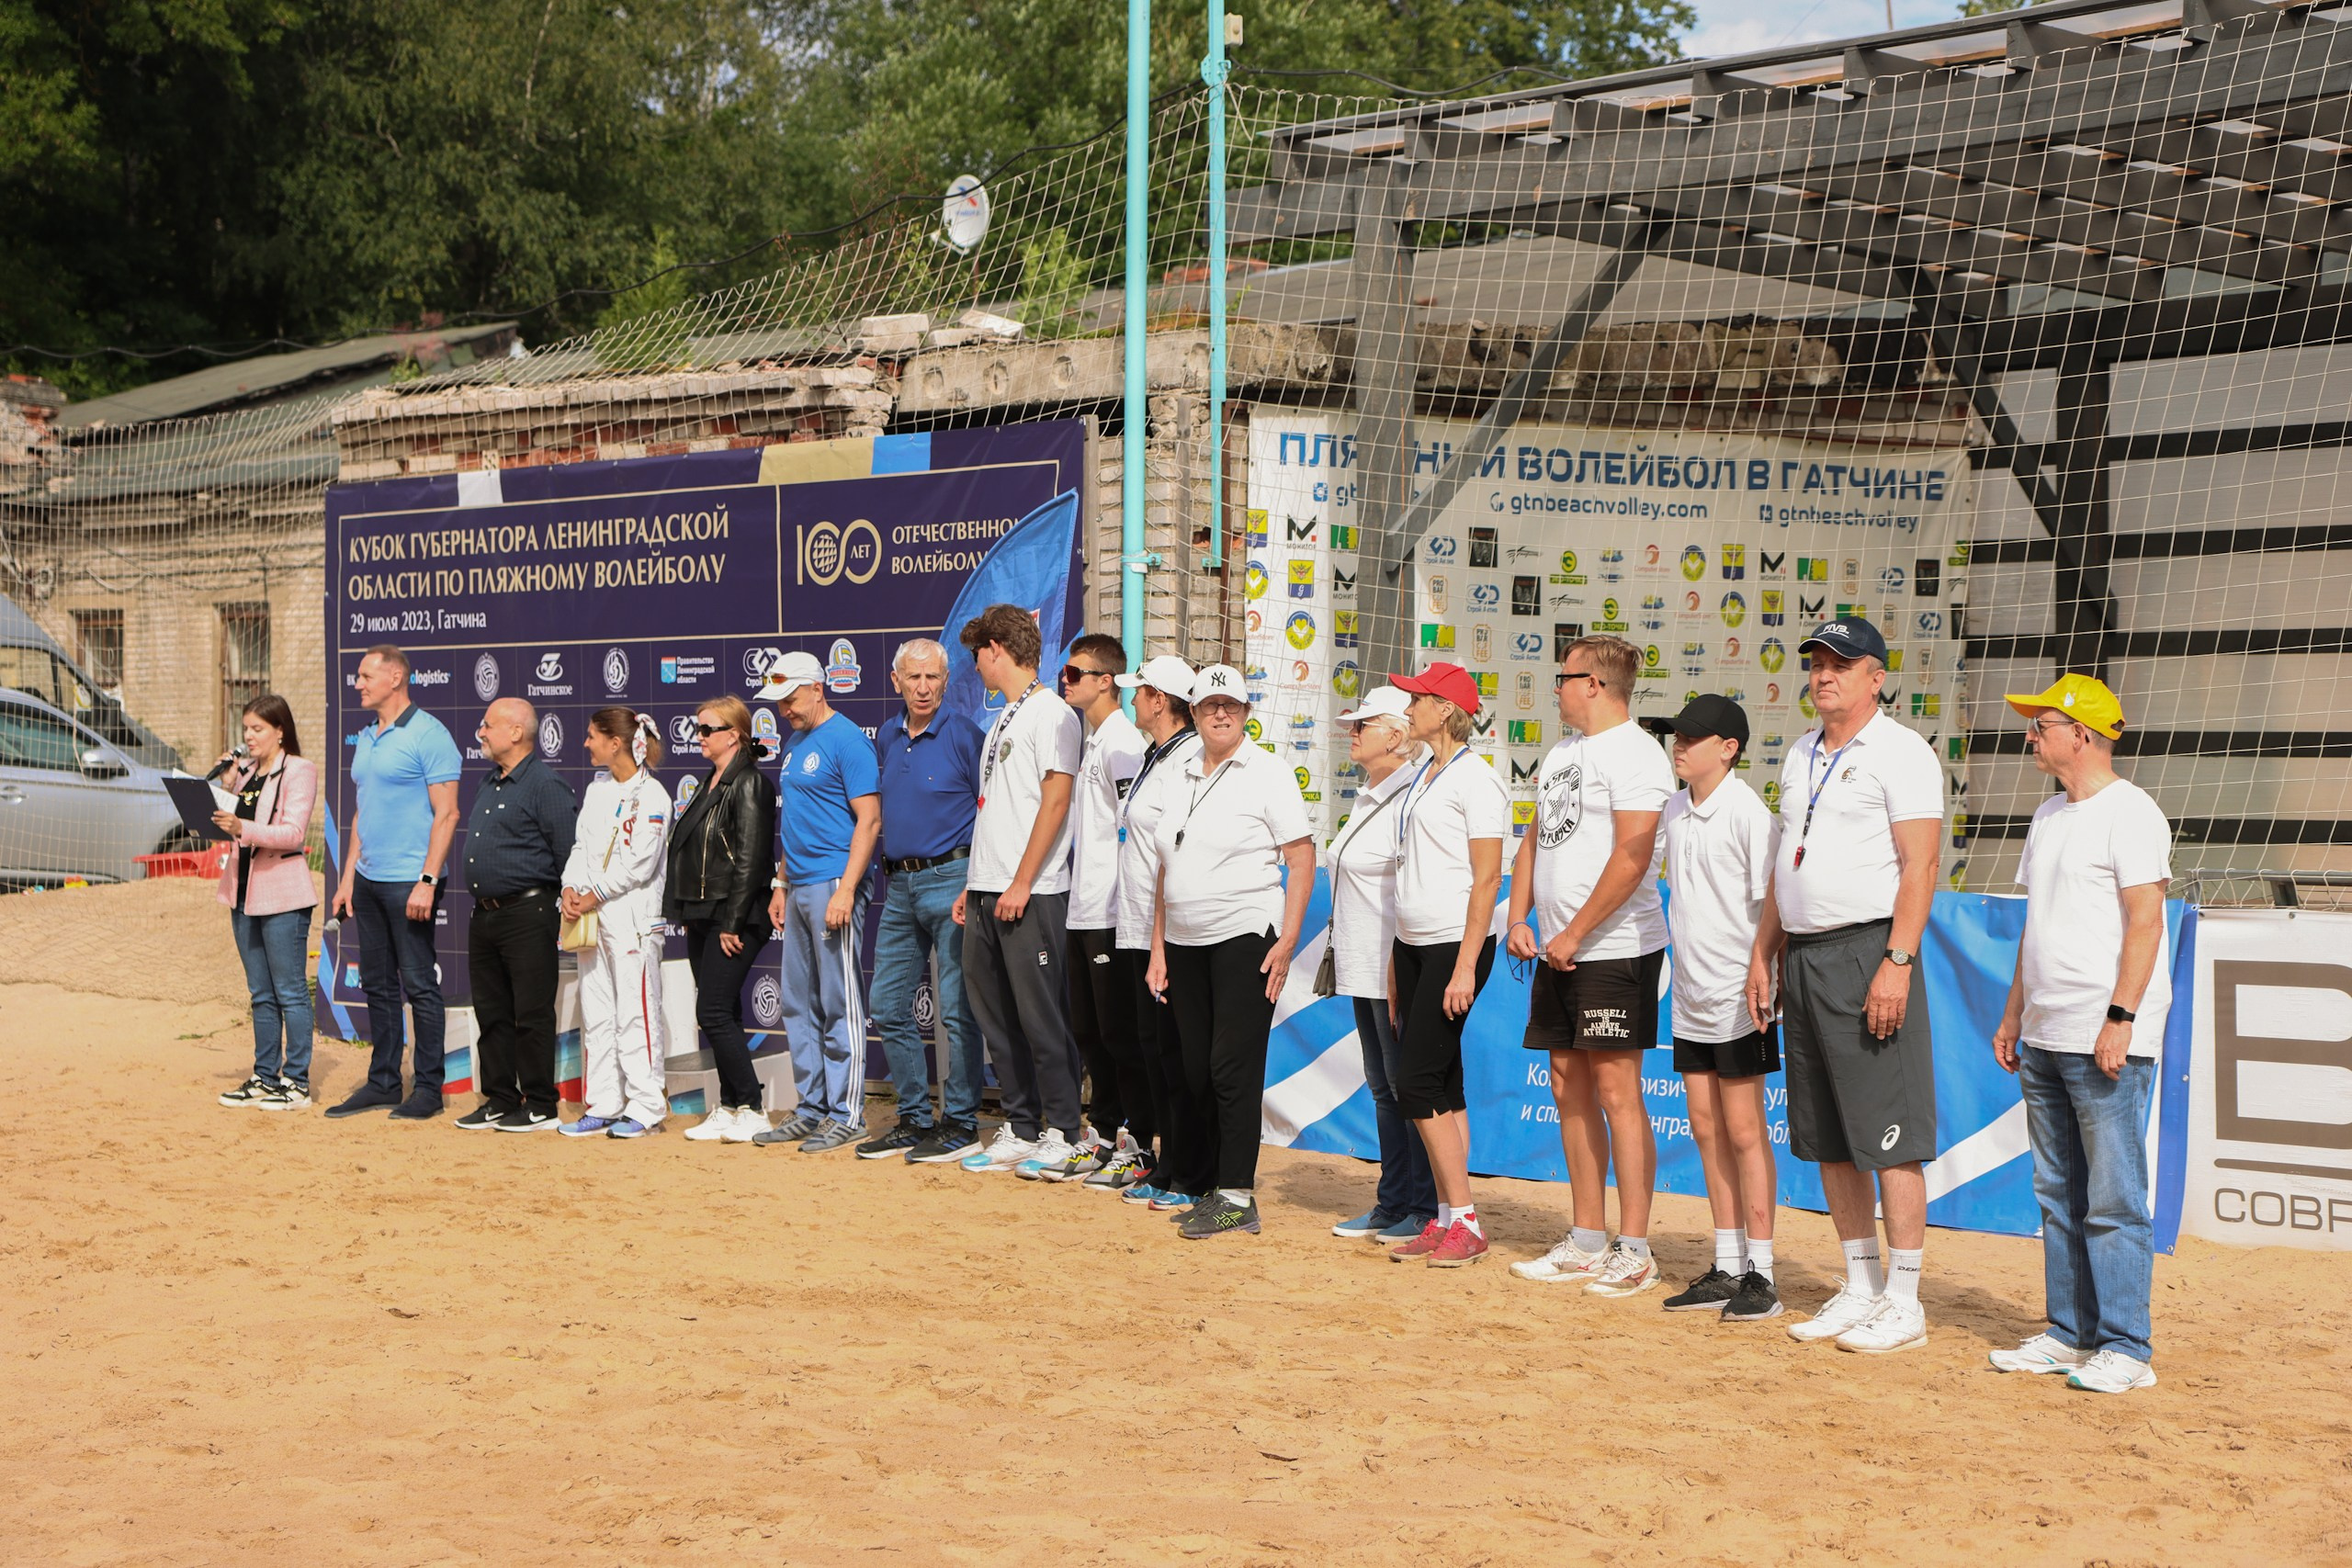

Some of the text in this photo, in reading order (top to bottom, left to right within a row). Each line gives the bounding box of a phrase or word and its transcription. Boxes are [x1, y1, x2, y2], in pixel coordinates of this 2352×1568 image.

[1518, 445, 1736, 490] ВОЛЕЙБОЛ
[1748, 460, 1770, 490] В
[1781, 461, 1945, 501] ГАТЧИНЕ
[1510, 492, 1708, 520] gtnbeachvolley.com
[1779, 505, 1917, 533] gtnbeachvolley
[349, 503, 729, 563] КУБОК ГУБЕРНАТОРА ЛЕНИНГРАДСКОЙ
[850, 543, 871, 558] ЛЕТ
[348, 550, 726, 601] ОБЛАСТИ ПО ПЛЯЖНОМУ ВОЛЕЙБОЛУ
[350, 610, 487, 634] 29 июля 2023, Гатчина
[677, 656, 714, 666] Правительство
[409, 669, 450, 687] ologistics
[677, 665, 715, 675] Ленинградской
[677, 675, 696, 684] области
[527, 683, 573, 696] Гатчинское
[1583, 1008, 1627, 1020] RUSSELL
[1583, 1028, 1630, 1039] ATHLETIC
